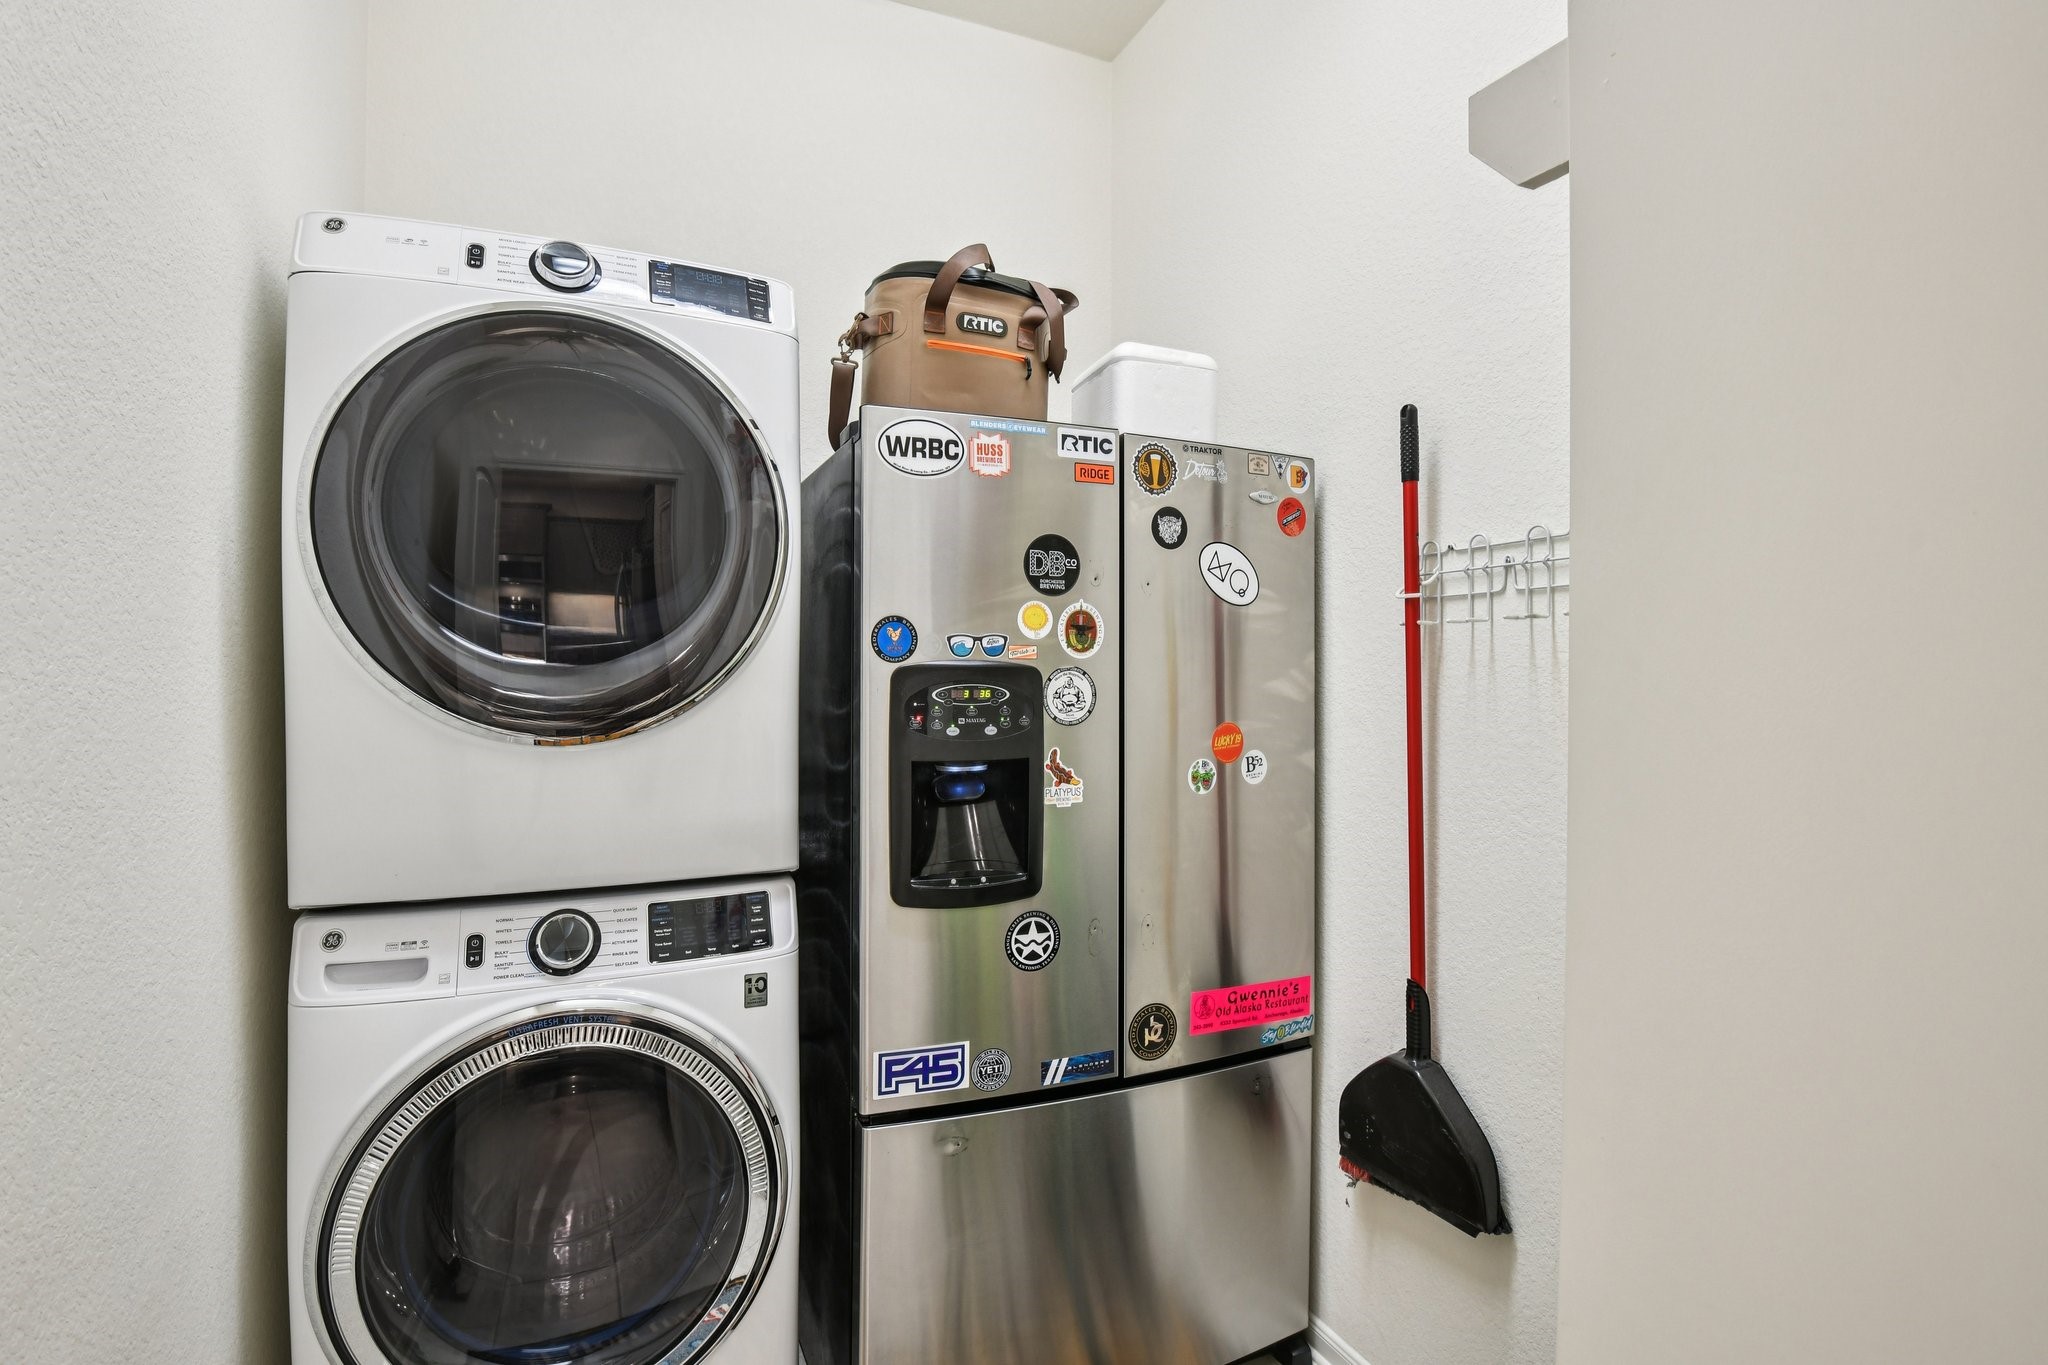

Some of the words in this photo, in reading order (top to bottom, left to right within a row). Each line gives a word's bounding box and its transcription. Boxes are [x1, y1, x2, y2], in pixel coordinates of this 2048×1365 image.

[963, 313, 1004, 334] RTIC
[970, 420, 1007, 429] BLENDERS
[1013, 424, 1046, 434] EYEWEAR
[885, 434, 960, 461] WRBC
[976, 442, 1003, 457] HUSS
[1061, 433, 1114, 455] RTIC
[1190, 445, 1222, 455] TRAKTOR
[1079, 467, 1111, 480] RIDGE
[872, 616, 897, 651] PEDERNALES
[902, 619, 917, 650] BREWING
[880, 651, 910, 662] COMPANY
[963, 689, 970, 698] 3
[979, 689, 991, 698] 36
[1214, 733, 1235, 747] LUCKY
[1045, 787, 1081, 797] PLATYPUS
[1009, 915, 1023, 931] CREEK
[1023, 911, 1046, 919] BREWING
[1049, 919, 1060, 950] DISTILLING
[1042, 952, 1055, 967] TEXAS
[745, 976, 767, 994] 10
[1227, 981, 1299, 1005] Gwennie's
[1215, 1007, 1231, 1019] Old
[1234, 1002, 1262, 1014] Alaska
[1265, 995, 1309, 1009] Restaurant
[507, 1018, 559, 1038] ULTRAFRESH
[563, 1015, 584, 1024] VENT
[588, 1014, 618, 1024] SYSTEM
[1131, 1007, 1156, 1047] PEDERNALES
[1161, 1009, 1174, 1040] BREWING
[1140, 1044, 1167, 1057] COMPANY
[883, 1050, 962, 1089] F45
[980, 1064, 1003, 1075] YETI
